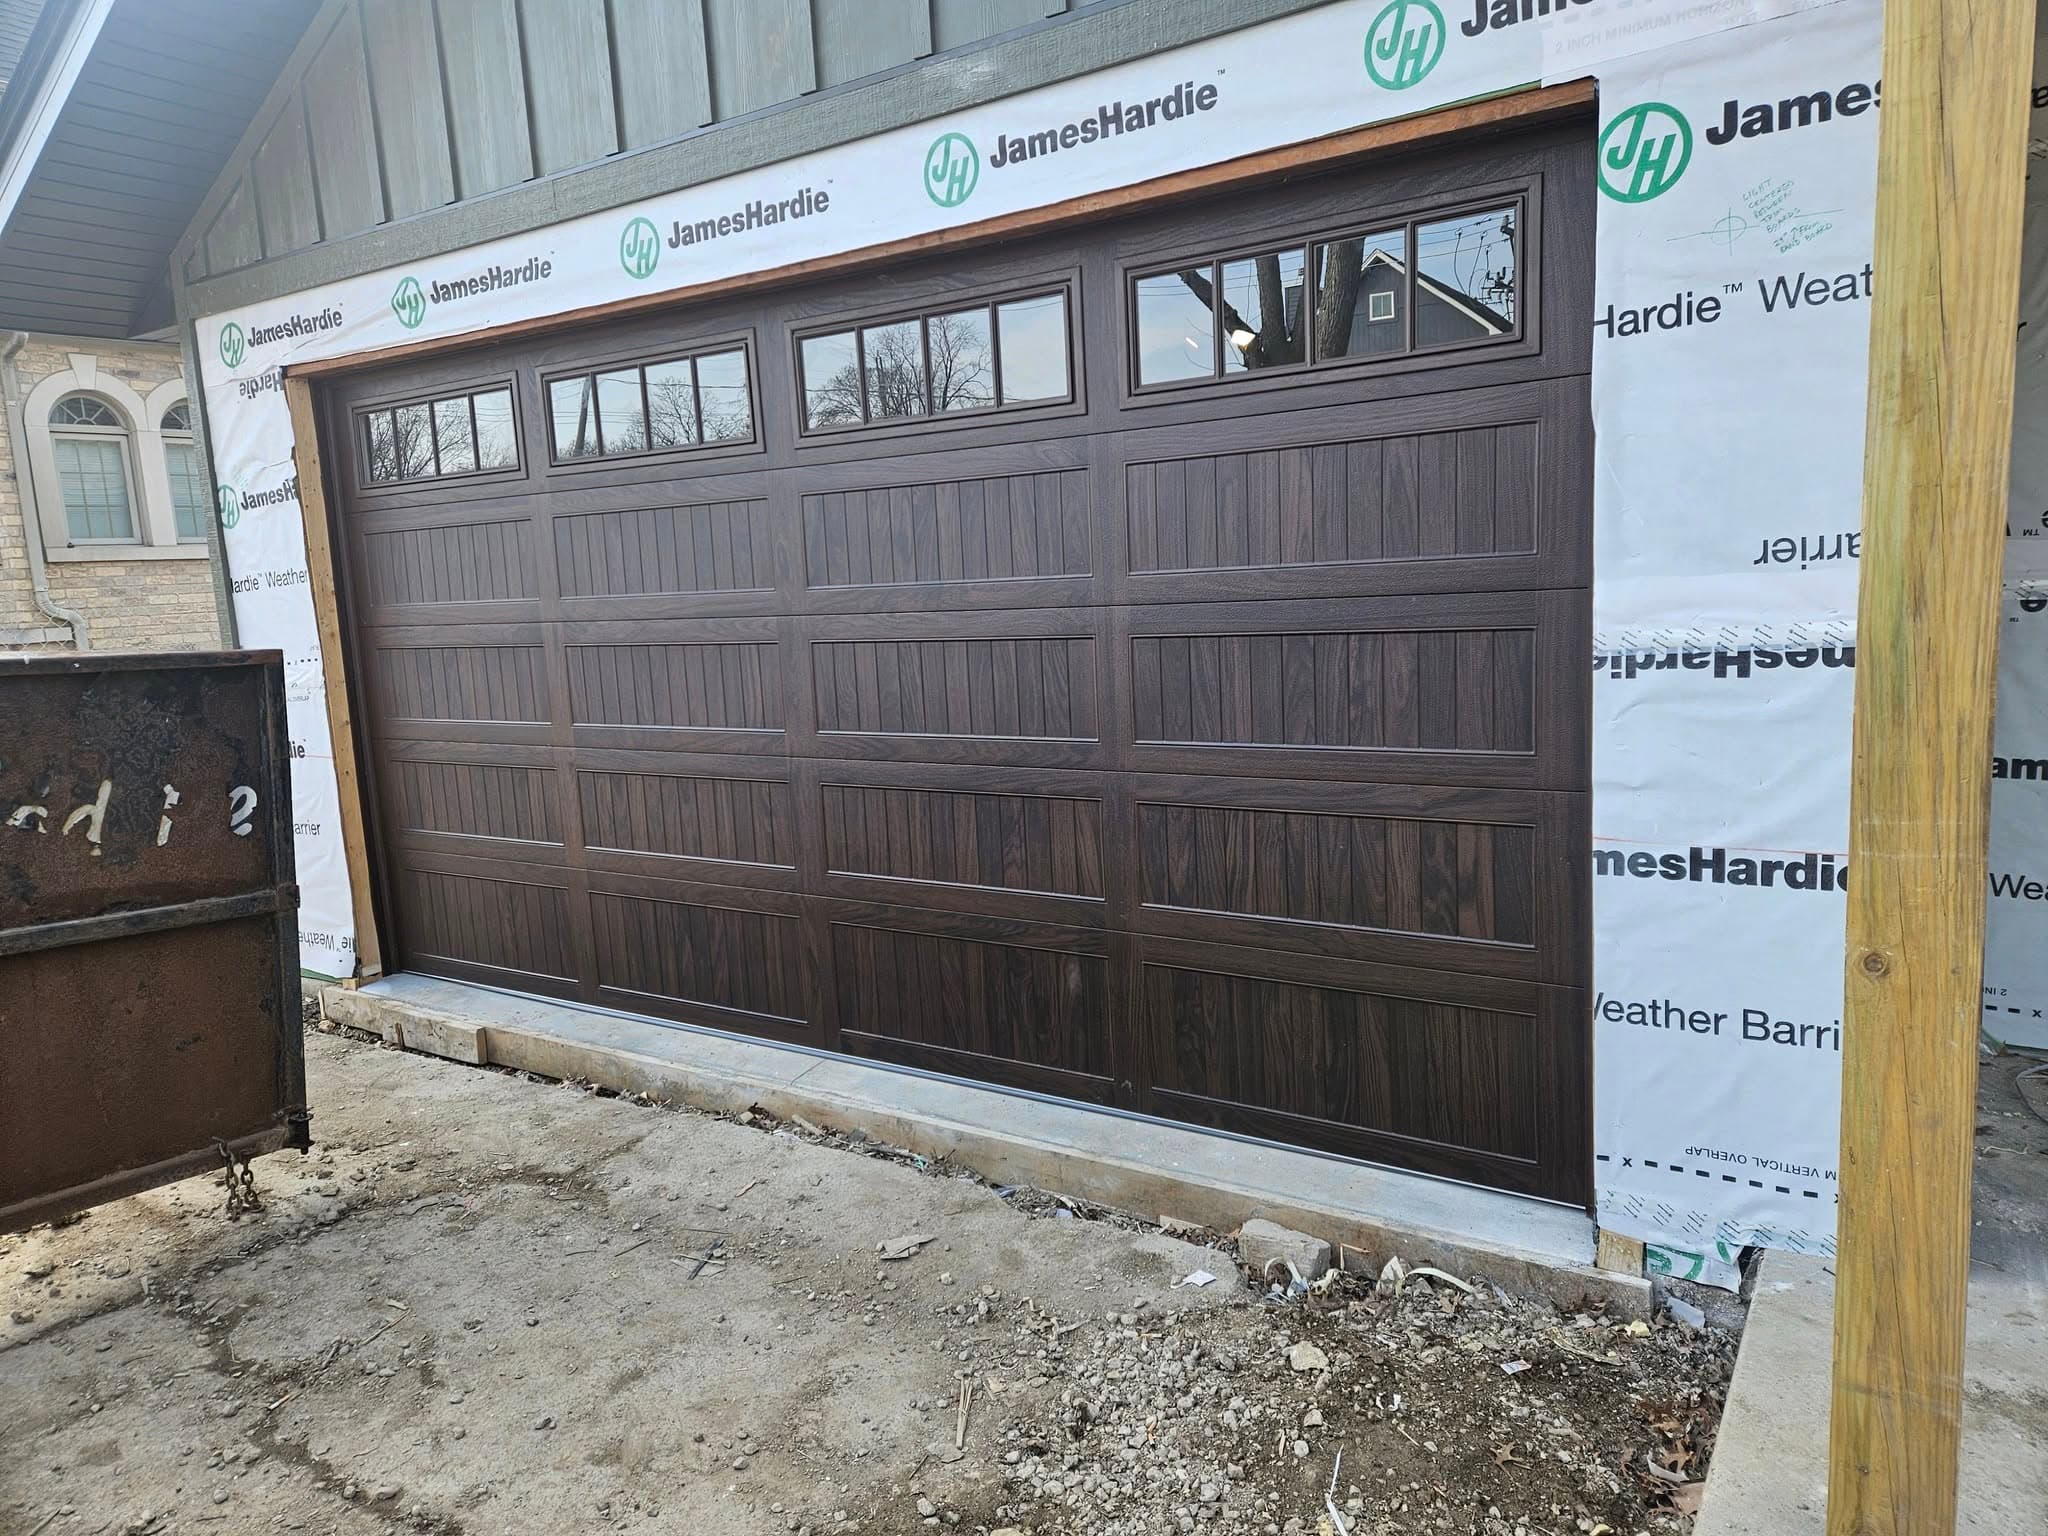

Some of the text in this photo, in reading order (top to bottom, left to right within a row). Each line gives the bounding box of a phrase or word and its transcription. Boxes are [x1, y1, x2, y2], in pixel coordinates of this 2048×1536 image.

[1706, 82, 1882, 146] Jame
[1684, 1145, 1747, 1165] OVERLAP
[1751, 1155, 1820, 1179] VERTICAL
